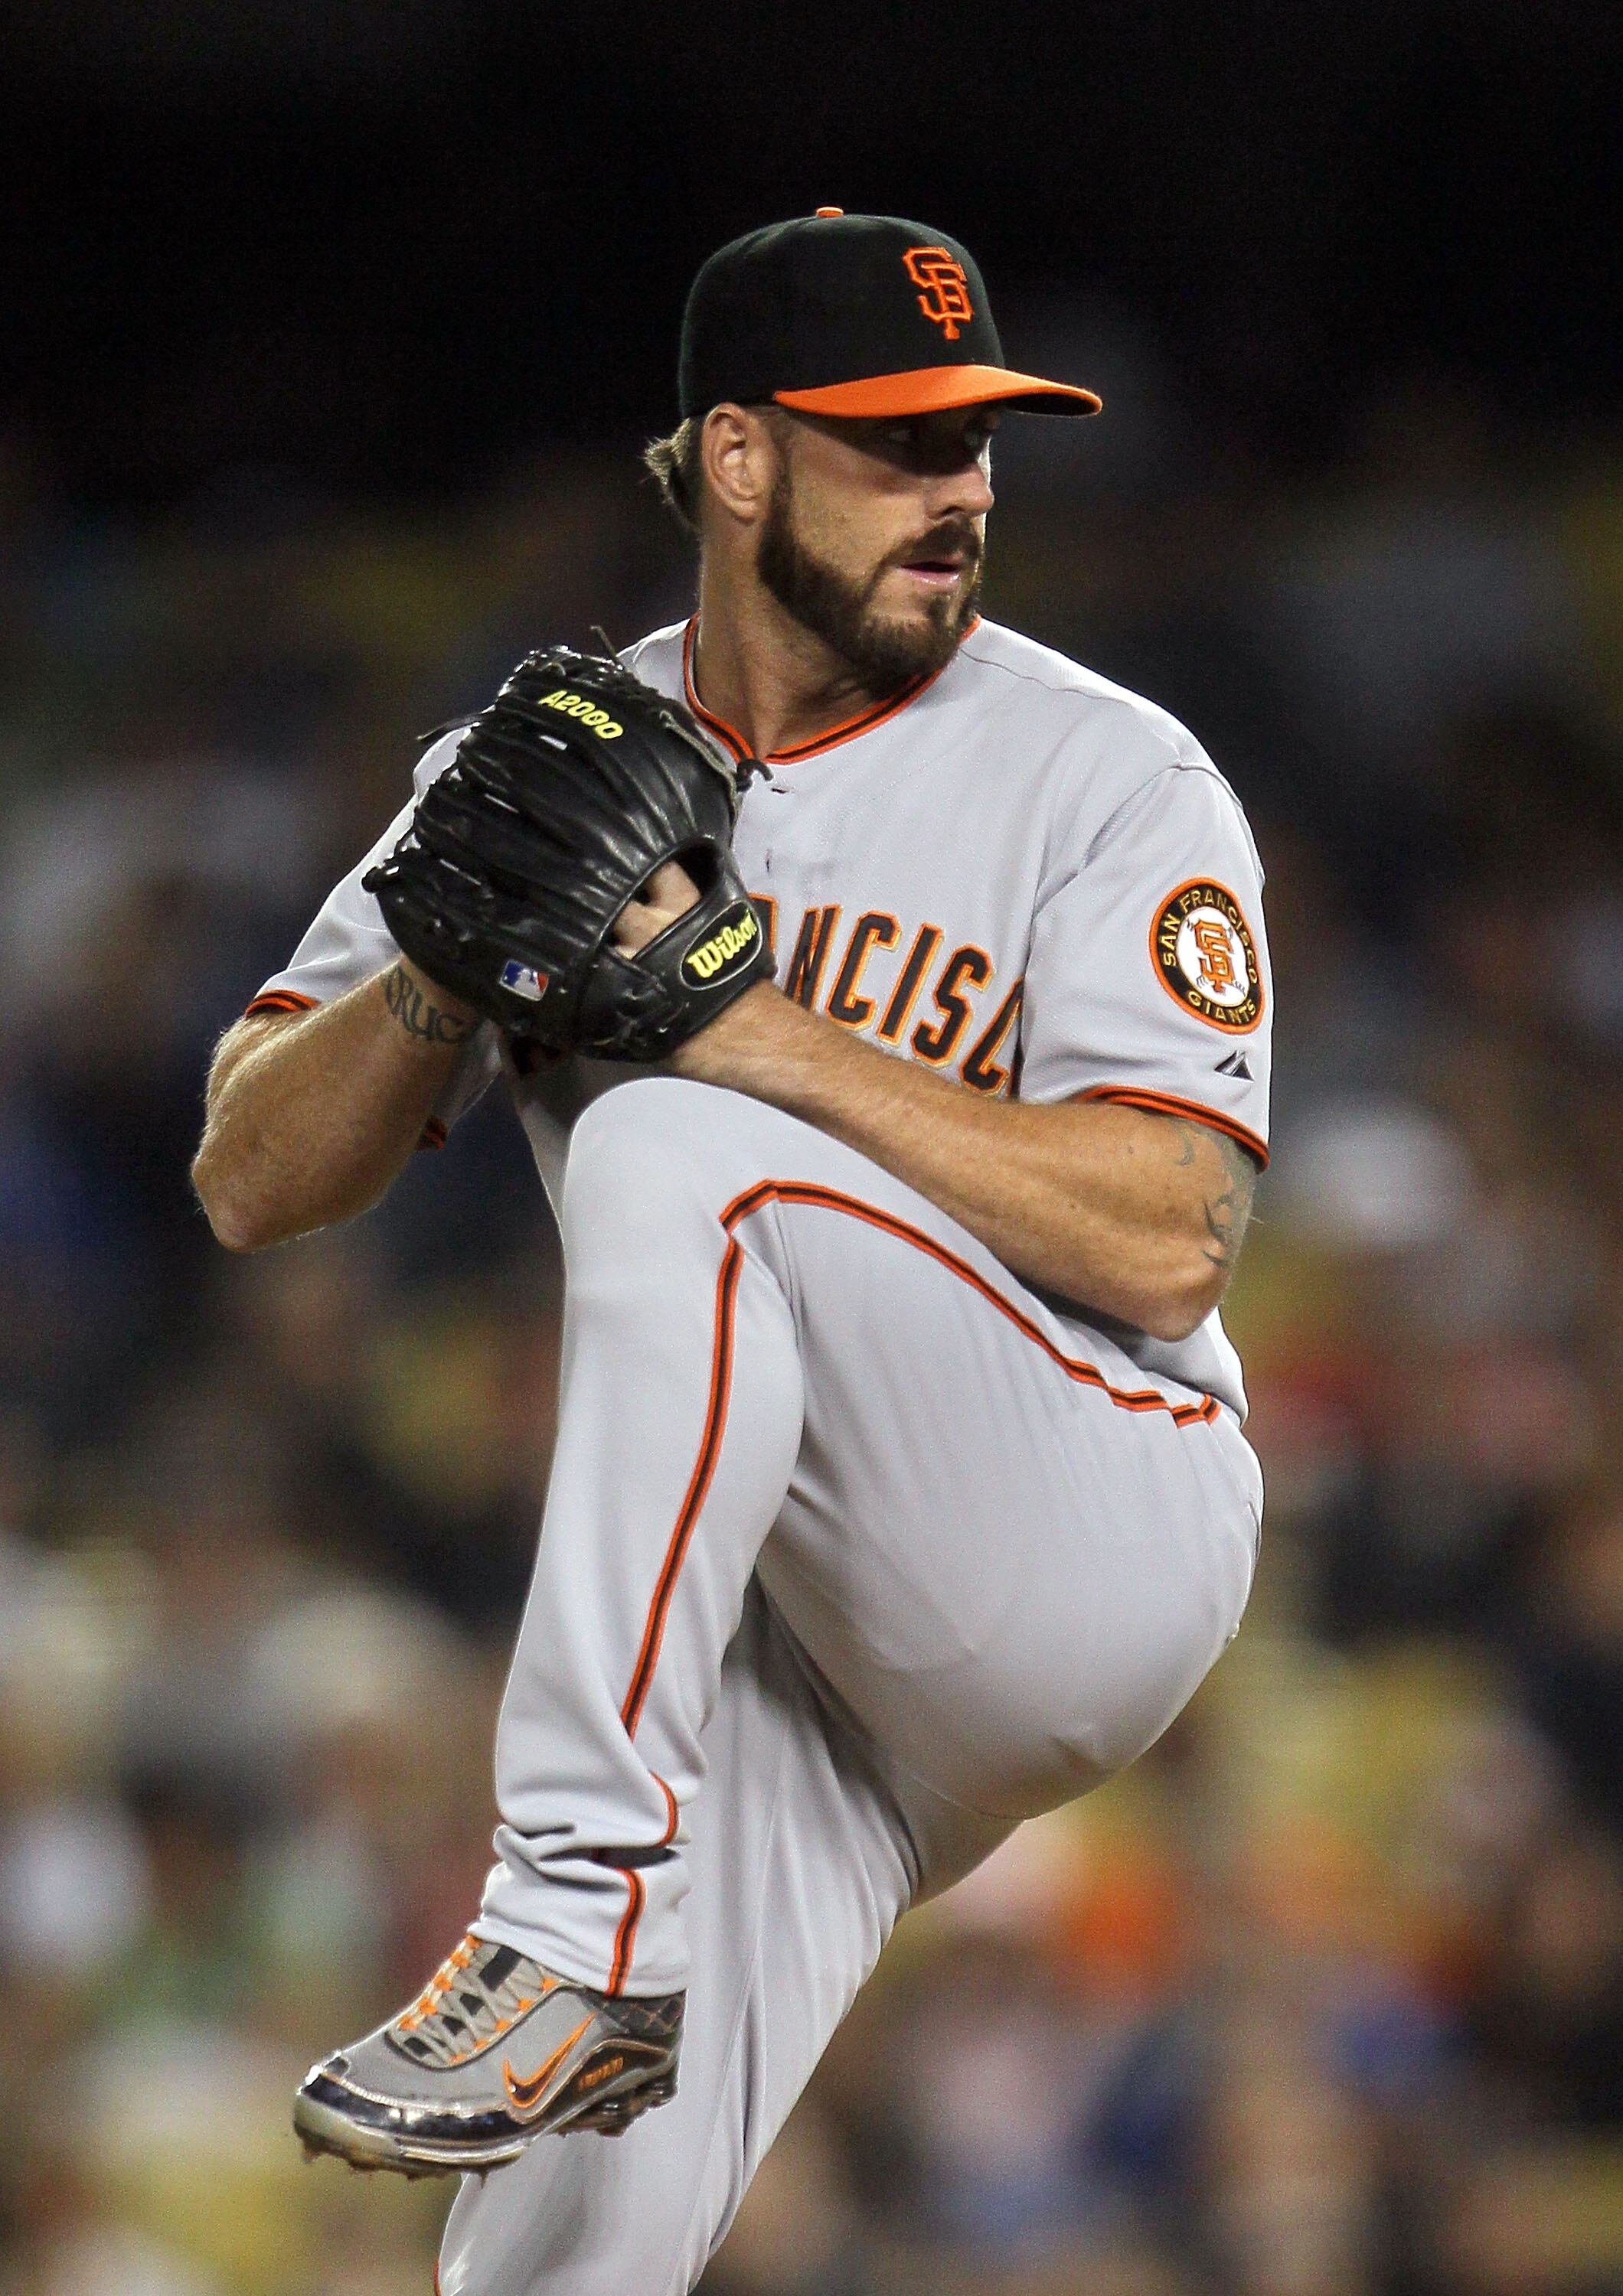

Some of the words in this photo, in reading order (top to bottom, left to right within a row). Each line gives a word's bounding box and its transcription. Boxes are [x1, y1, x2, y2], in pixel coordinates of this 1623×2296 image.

[902, 246, 972, 340] SF
[537, 690, 624, 739] A2000
[686, 908, 758, 979] Wilson
[1161, 913, 1181, 967] SAN
[1179, 889, 1258, 984] FRANCISCO
[1187, 990, 1256, 1024] GIANTS
